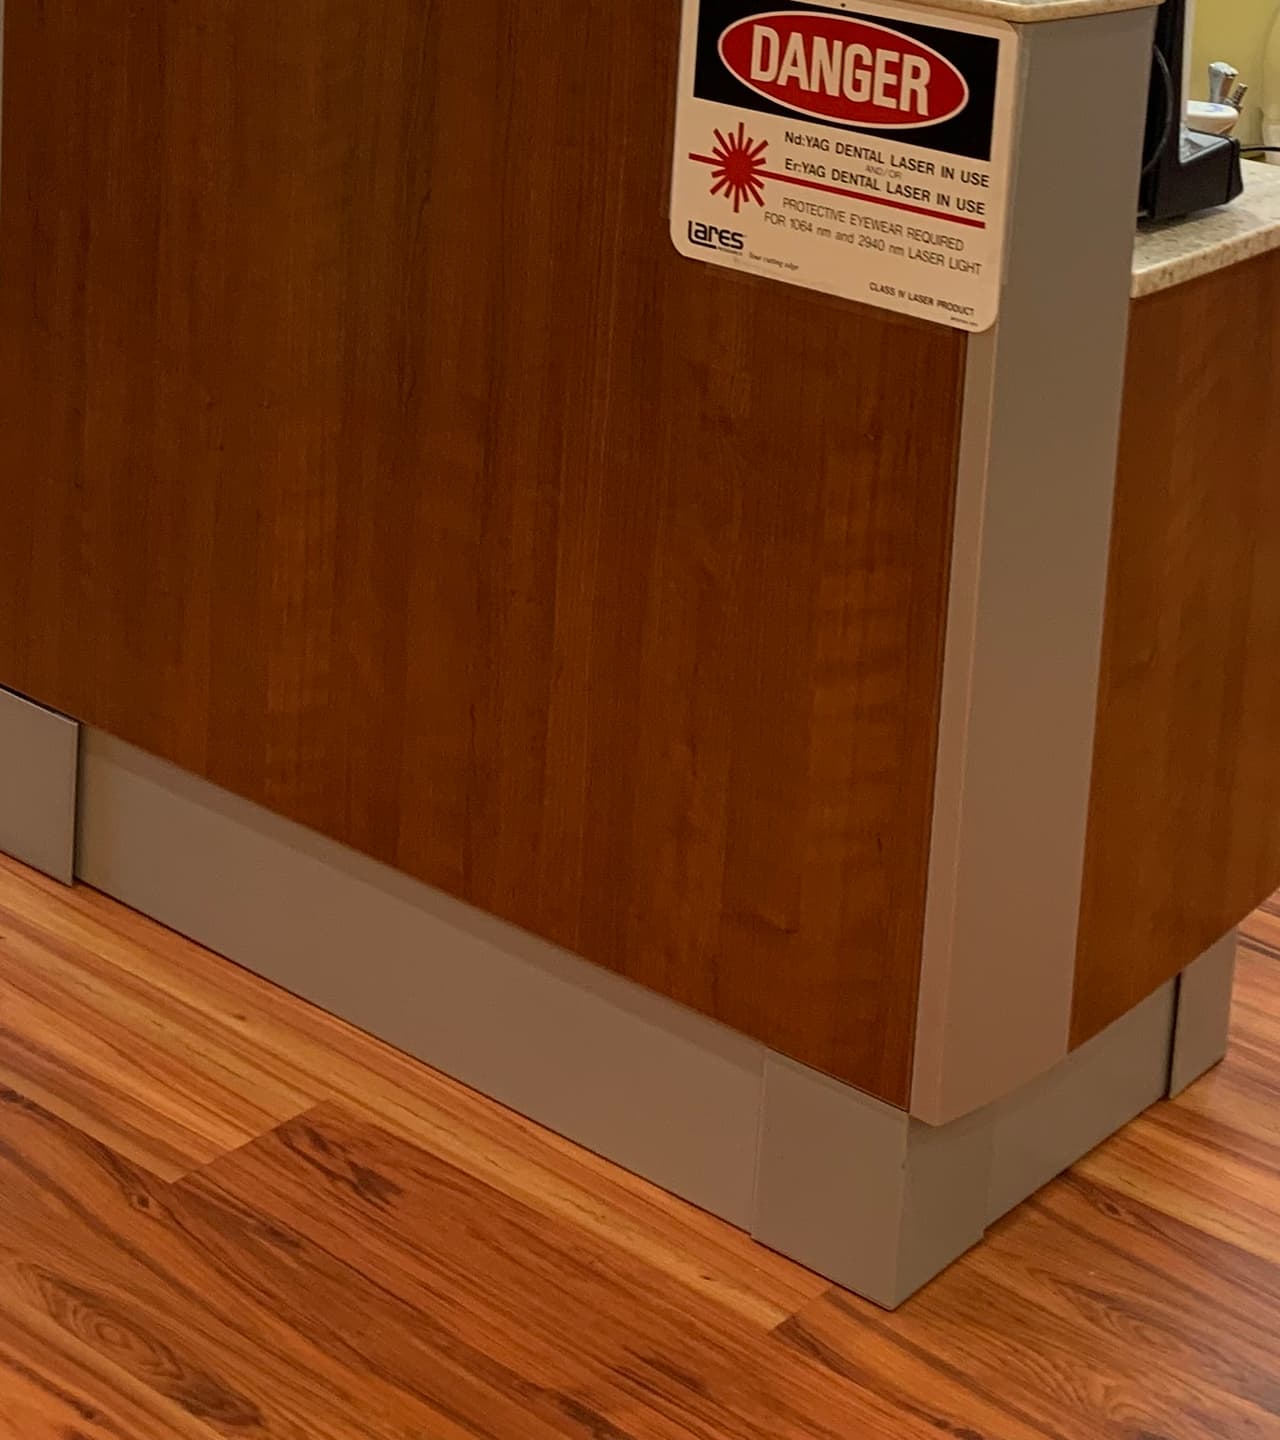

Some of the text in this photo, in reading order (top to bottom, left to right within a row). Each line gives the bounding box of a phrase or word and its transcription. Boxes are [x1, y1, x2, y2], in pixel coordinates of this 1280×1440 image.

[750, 24, 931, 116] DANGER
[784, 131, 990, 188] Nd:YAG DENTAL LASER IN USE
[784, 157, 985, 216] Er:YAG DENTAL LASER IN USE
[764, 211, 982, 276] FOR 1064 nm and 2940 nm LASER LIGHT
[782, 197, 964, 251] PROTECTIVE EYEWEAR REQUIRED
[869, 282, 896, 296] CLASS
[908, 292, 934, 306] LASER
[936, 299, 975, 316] PRODUCT
